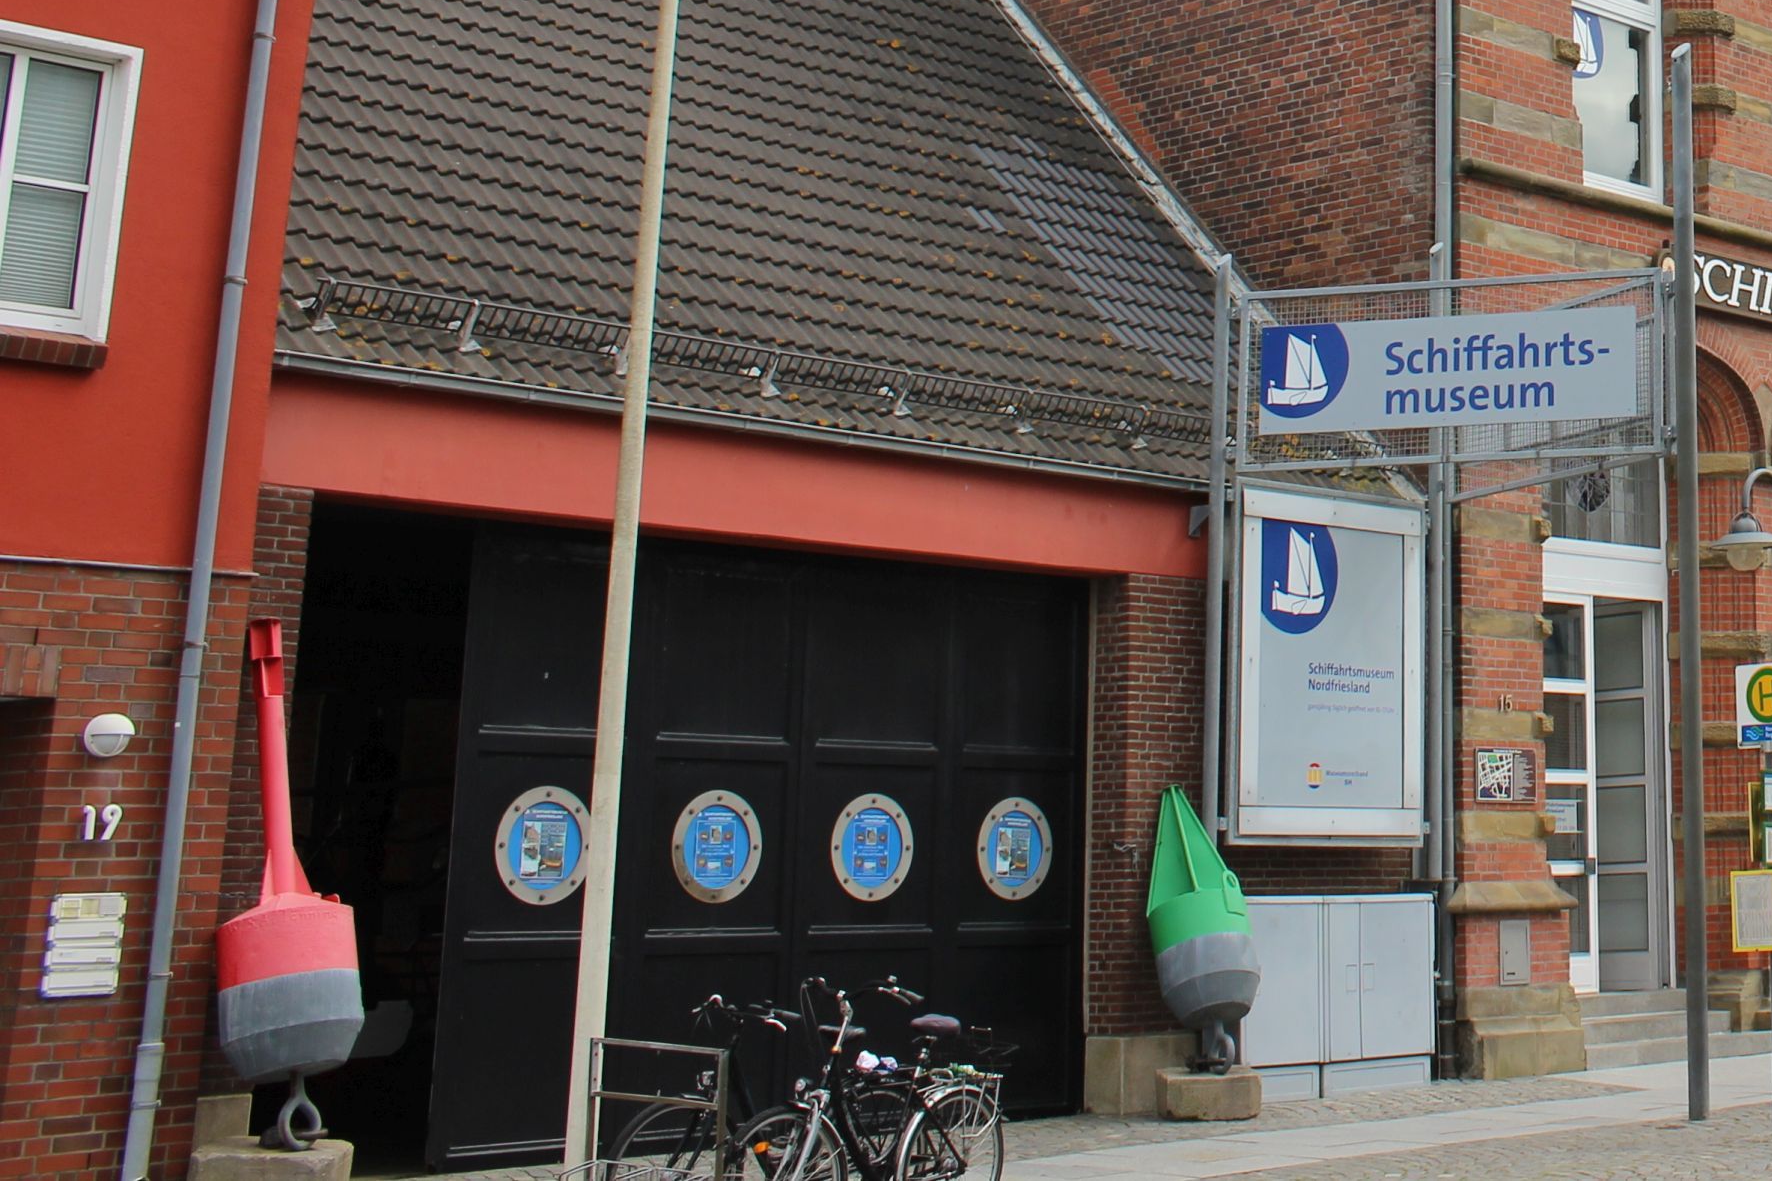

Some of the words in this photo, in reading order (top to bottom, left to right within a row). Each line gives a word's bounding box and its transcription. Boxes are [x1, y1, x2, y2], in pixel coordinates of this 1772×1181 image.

[1384, 332, 1611, 376] Schiffahrts-
[1384, 380, 1556, 415] museum
[1308, 662, 1395, 680] Schiffahrtsmuseum
[1308, 678, 1370, 694] Nordfriesland
[1499, 693, 1513, 712] 15
[83, 804, 123, 841] 19
